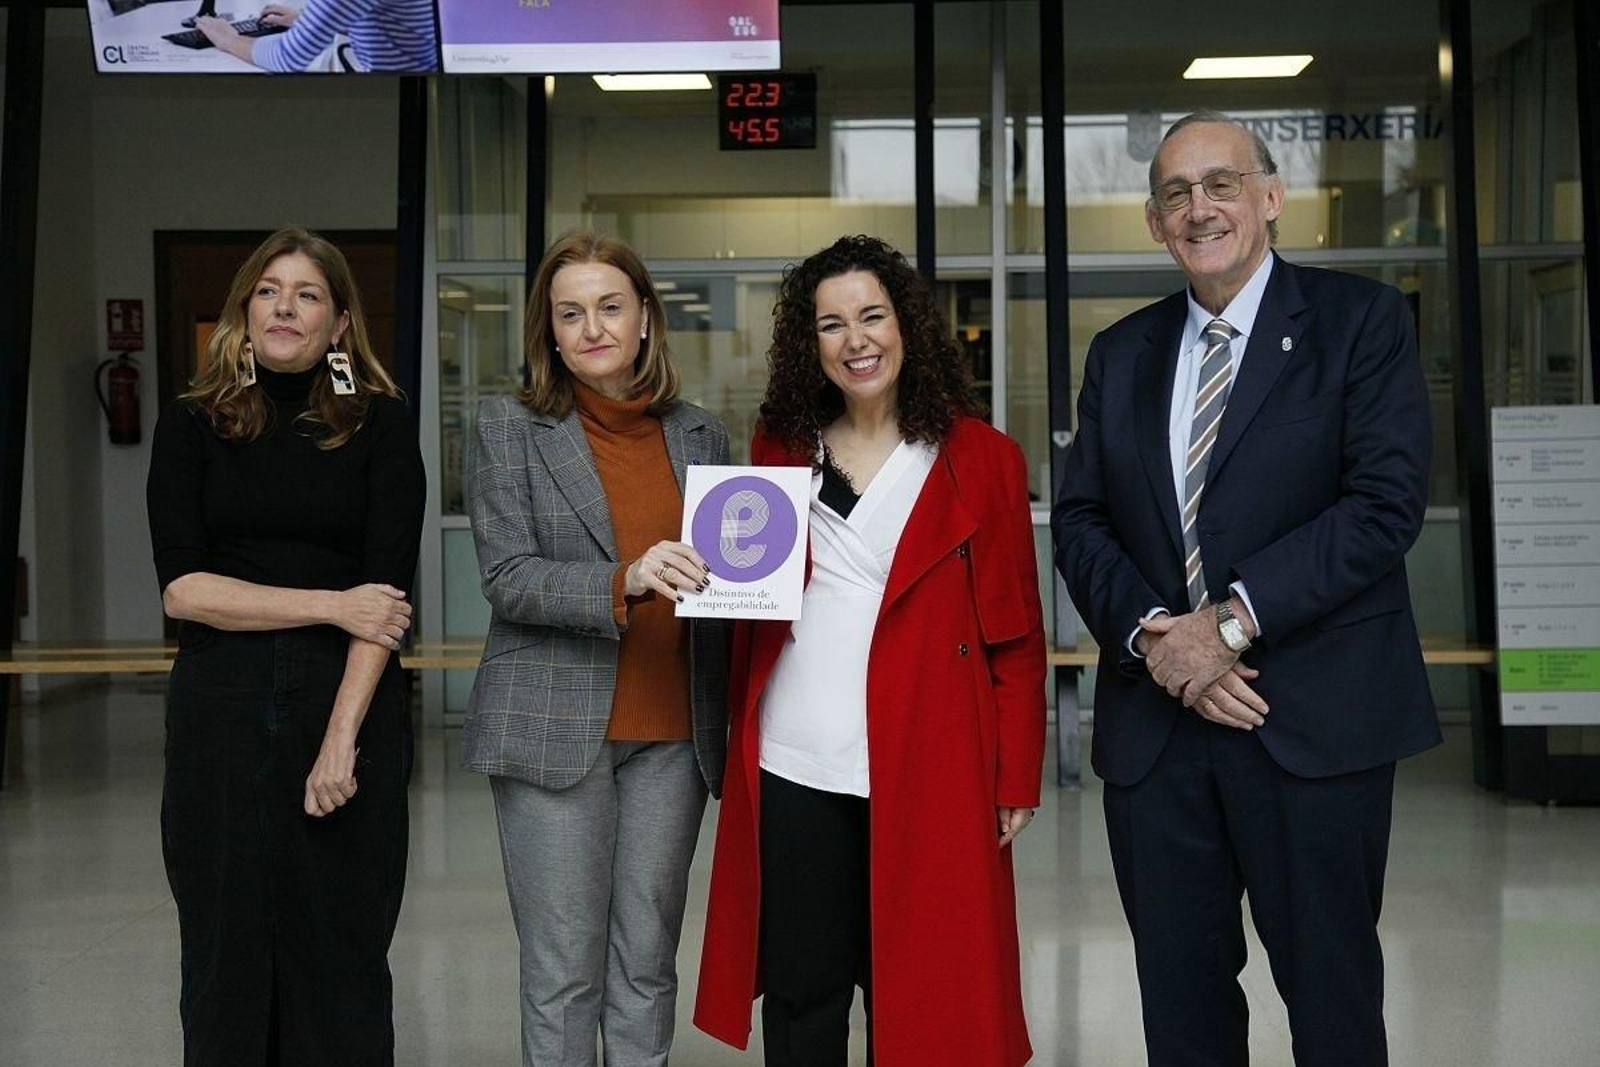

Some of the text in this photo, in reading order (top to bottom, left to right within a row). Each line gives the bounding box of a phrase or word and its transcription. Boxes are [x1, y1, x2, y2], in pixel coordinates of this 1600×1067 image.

[708, 587, 770, 599] Distintivo de
[696, 599, 780, 611] empregabilidade
